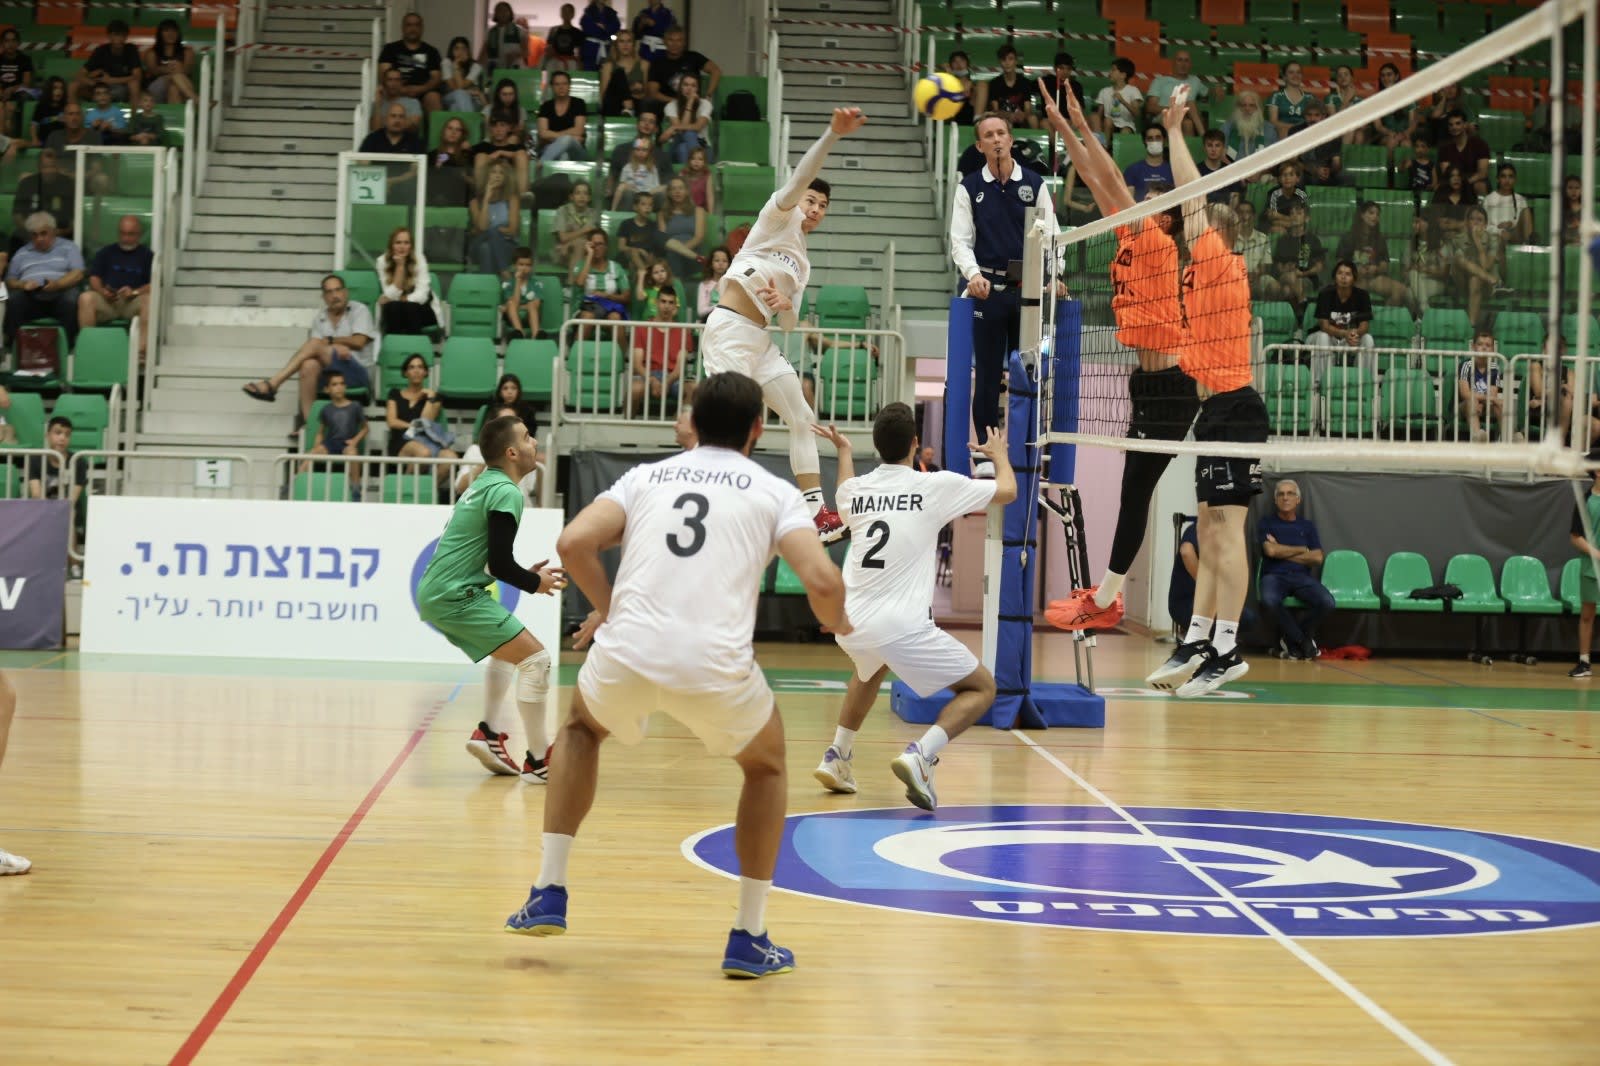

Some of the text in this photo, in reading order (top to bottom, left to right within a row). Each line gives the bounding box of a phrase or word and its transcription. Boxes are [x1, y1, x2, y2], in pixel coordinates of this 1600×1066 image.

[1289, 105, 1302, 116] 34
[358, 185, 375, 199] ב
[648, 466, 752, 490] HERSHKO
[850, 493, 924, 515] MAINER
[665, 492, 710, 558] 3
[861, 520, 891, 569] 2
[120, 542, 380, 588] קבוצת ח.י.
[117, 593, 379, 622] חושבים יותר. עליך.
[969, 900, 1550, 922] מפעל הפיס
